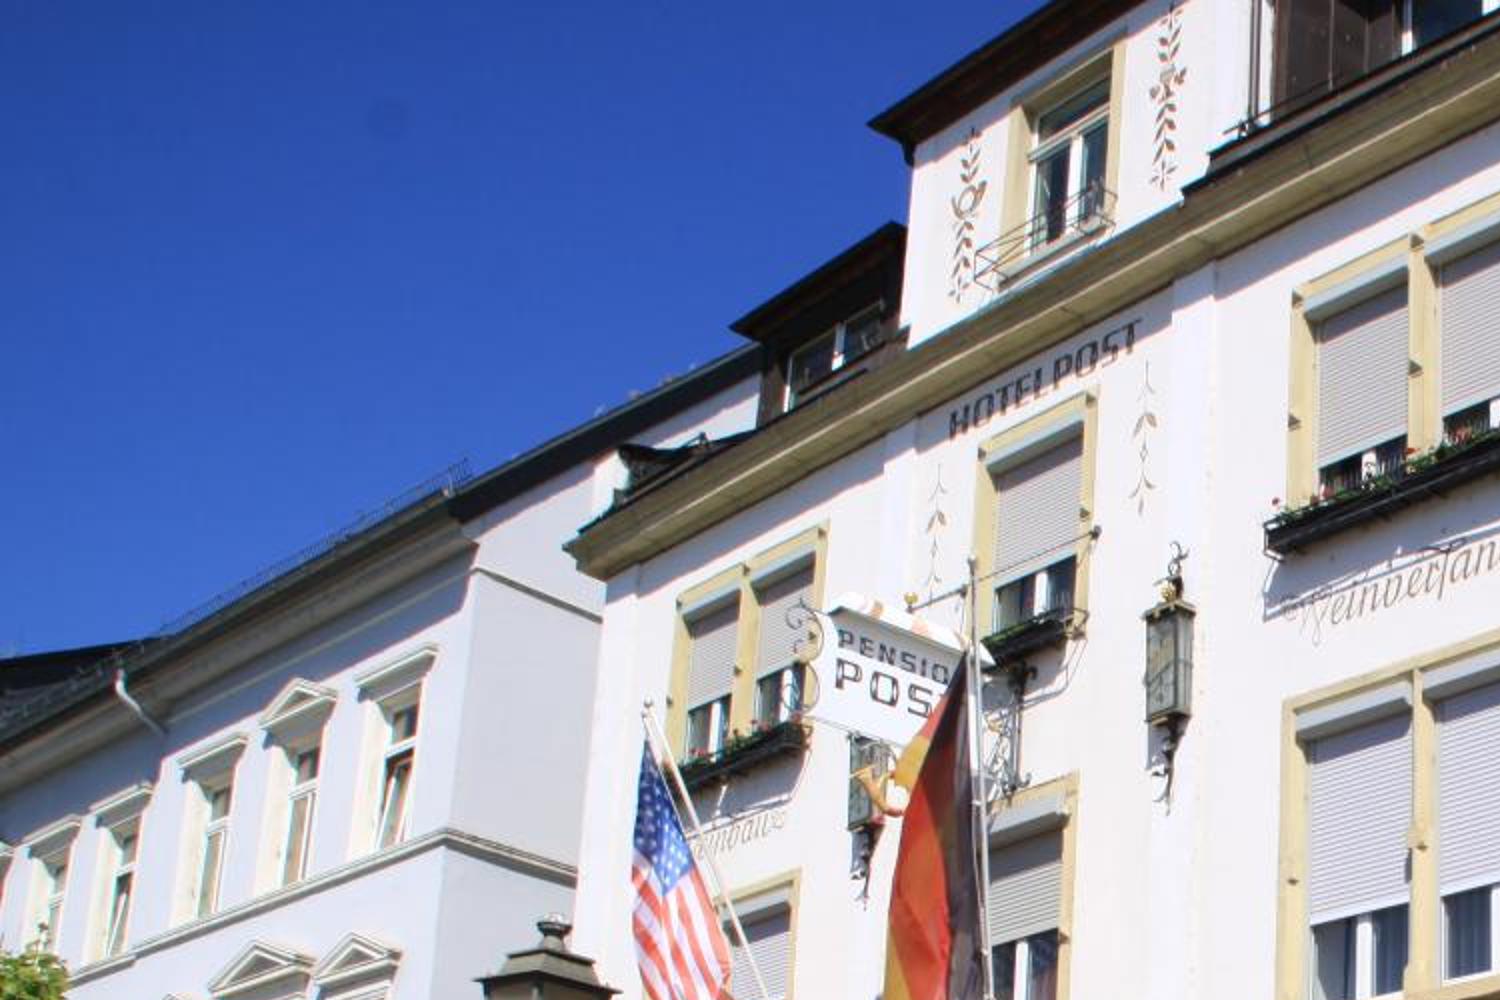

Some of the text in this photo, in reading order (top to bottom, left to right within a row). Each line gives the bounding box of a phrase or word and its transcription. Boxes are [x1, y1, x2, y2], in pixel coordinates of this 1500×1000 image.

[1053, 317, 1144, 390] POST
[835, 657, 936, 719] POS
[837, 628, 950, 686] PENSIO
